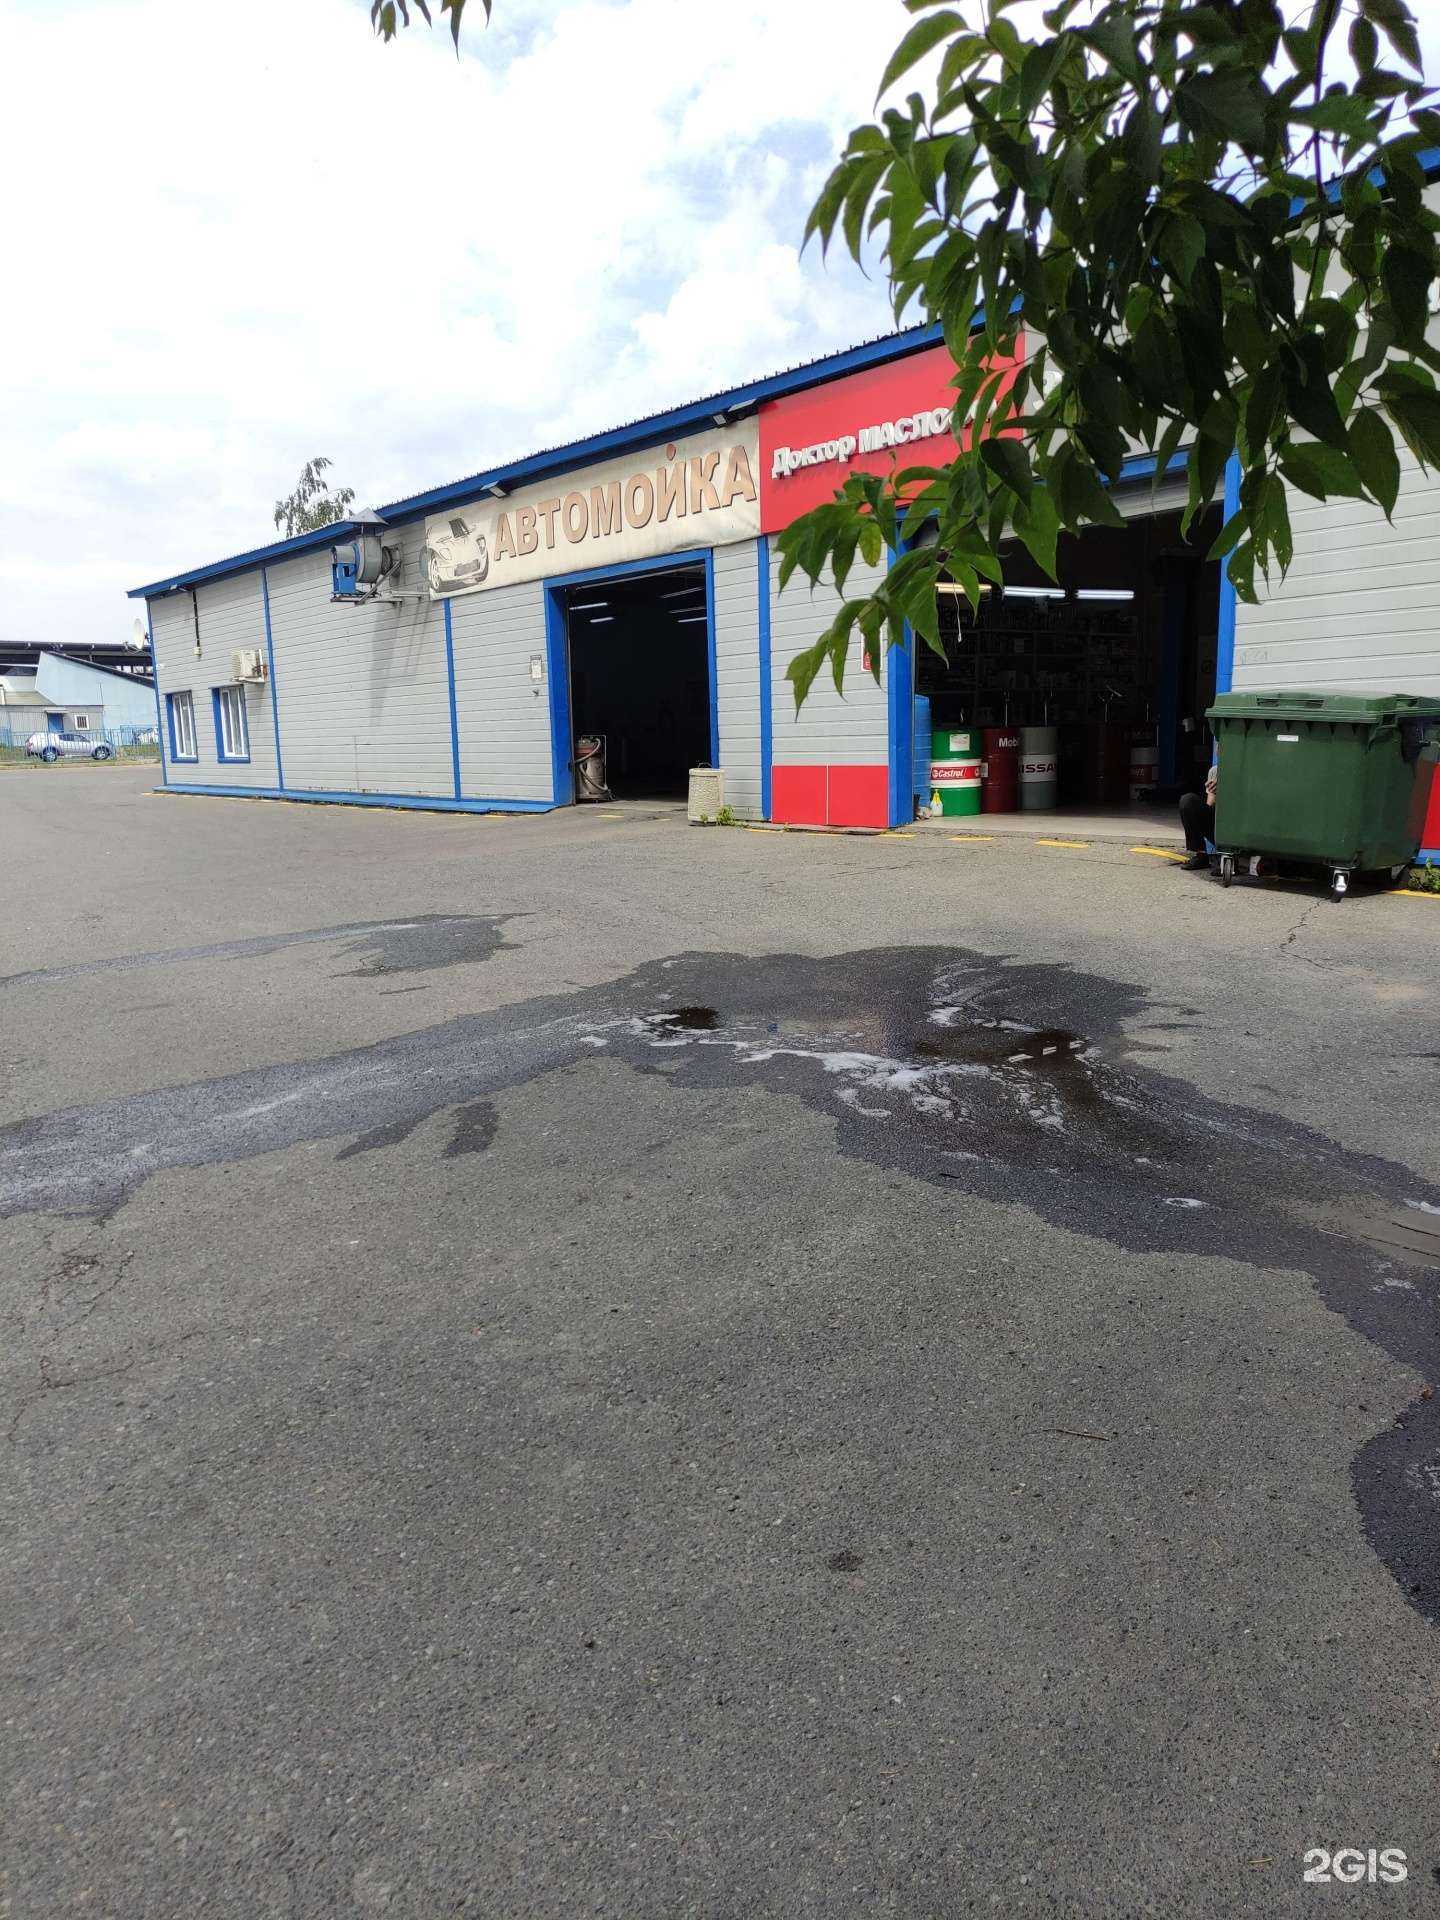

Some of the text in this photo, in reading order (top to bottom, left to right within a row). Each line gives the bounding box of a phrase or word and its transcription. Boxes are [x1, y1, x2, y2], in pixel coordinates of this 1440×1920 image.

[771, 435, 857, 479] Доктор
[494, 443, 757, 562] АВТОМОЙКА
[938, 767, 964, 778] Castrol
